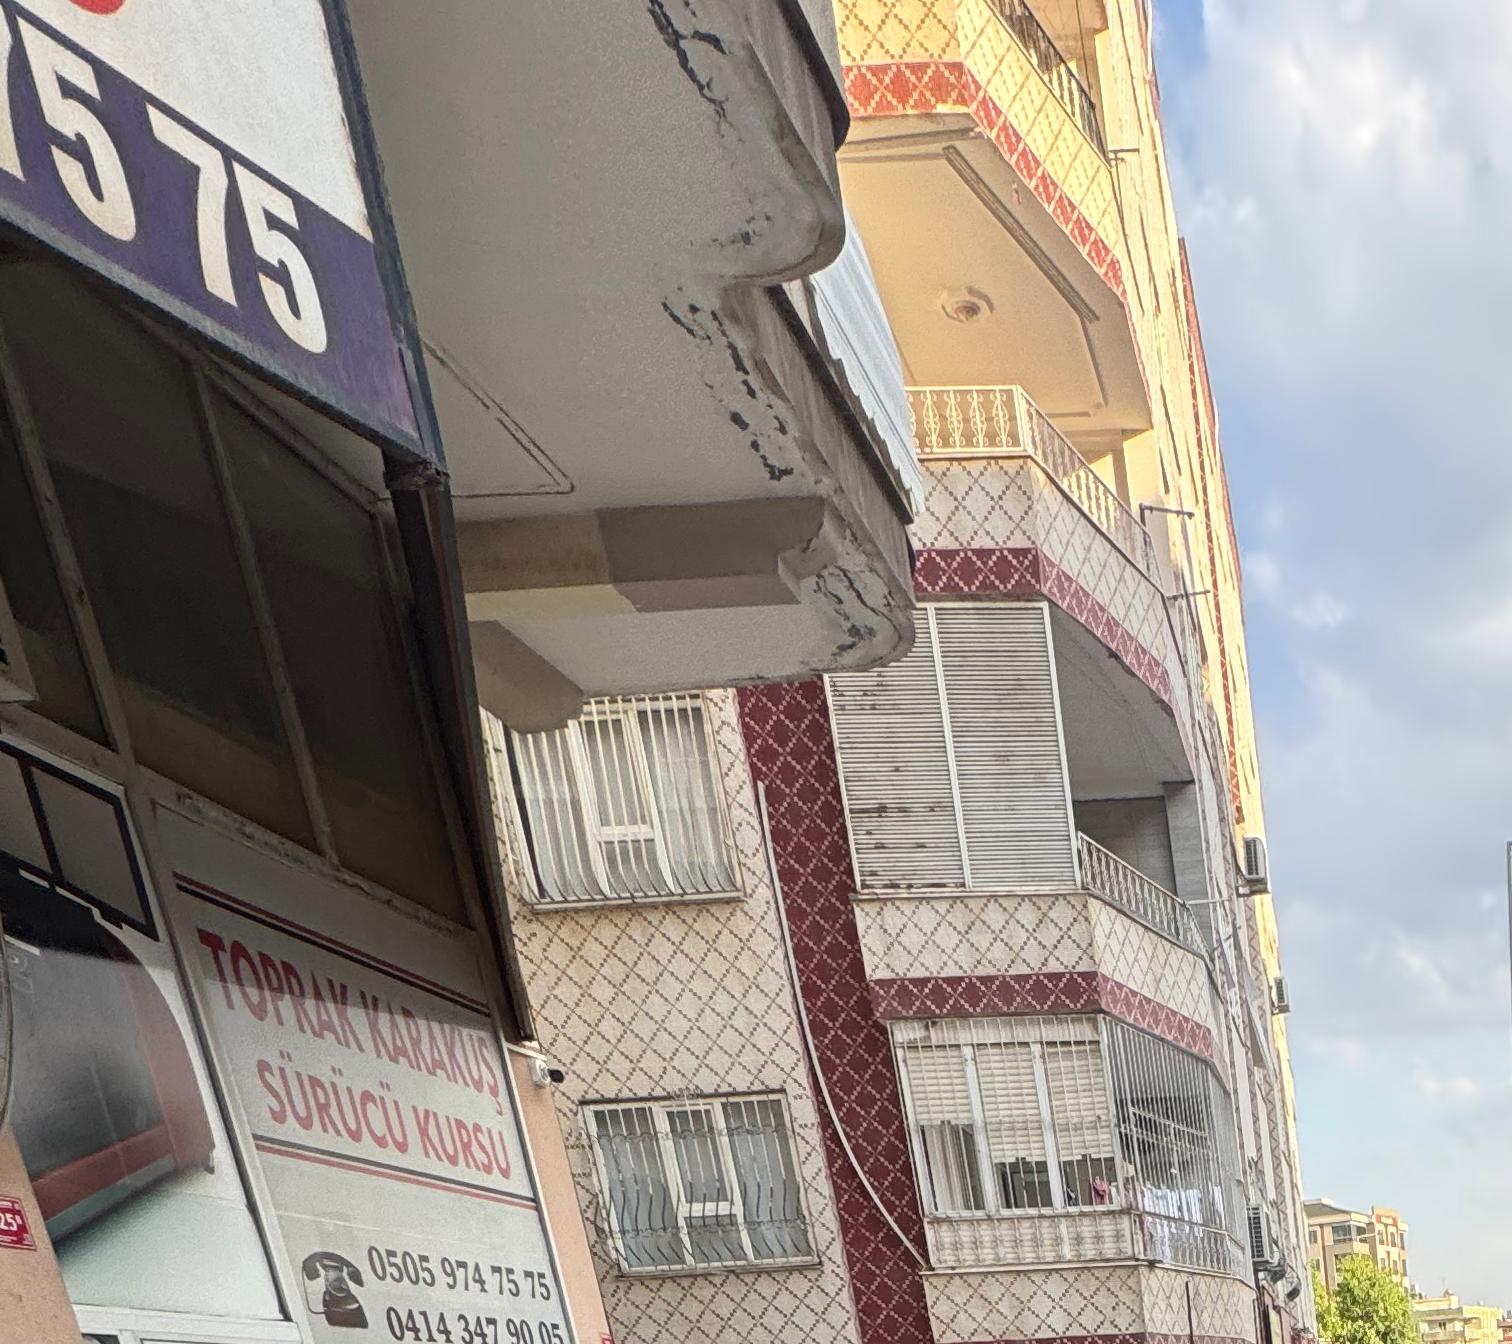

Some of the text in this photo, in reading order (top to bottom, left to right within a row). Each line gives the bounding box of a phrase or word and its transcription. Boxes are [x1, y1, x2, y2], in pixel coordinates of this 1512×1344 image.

[146, 102, 327, 354] 75
[197, 927, 504, 1116] TOPRAK KARAKUŞ
[257, 1051, 510, 1179] SÜRÜCÜ KURSU
[368, 1246, 551, 1300] 0505 974 75 75
[387, 1307, 452, 1344] 0414
